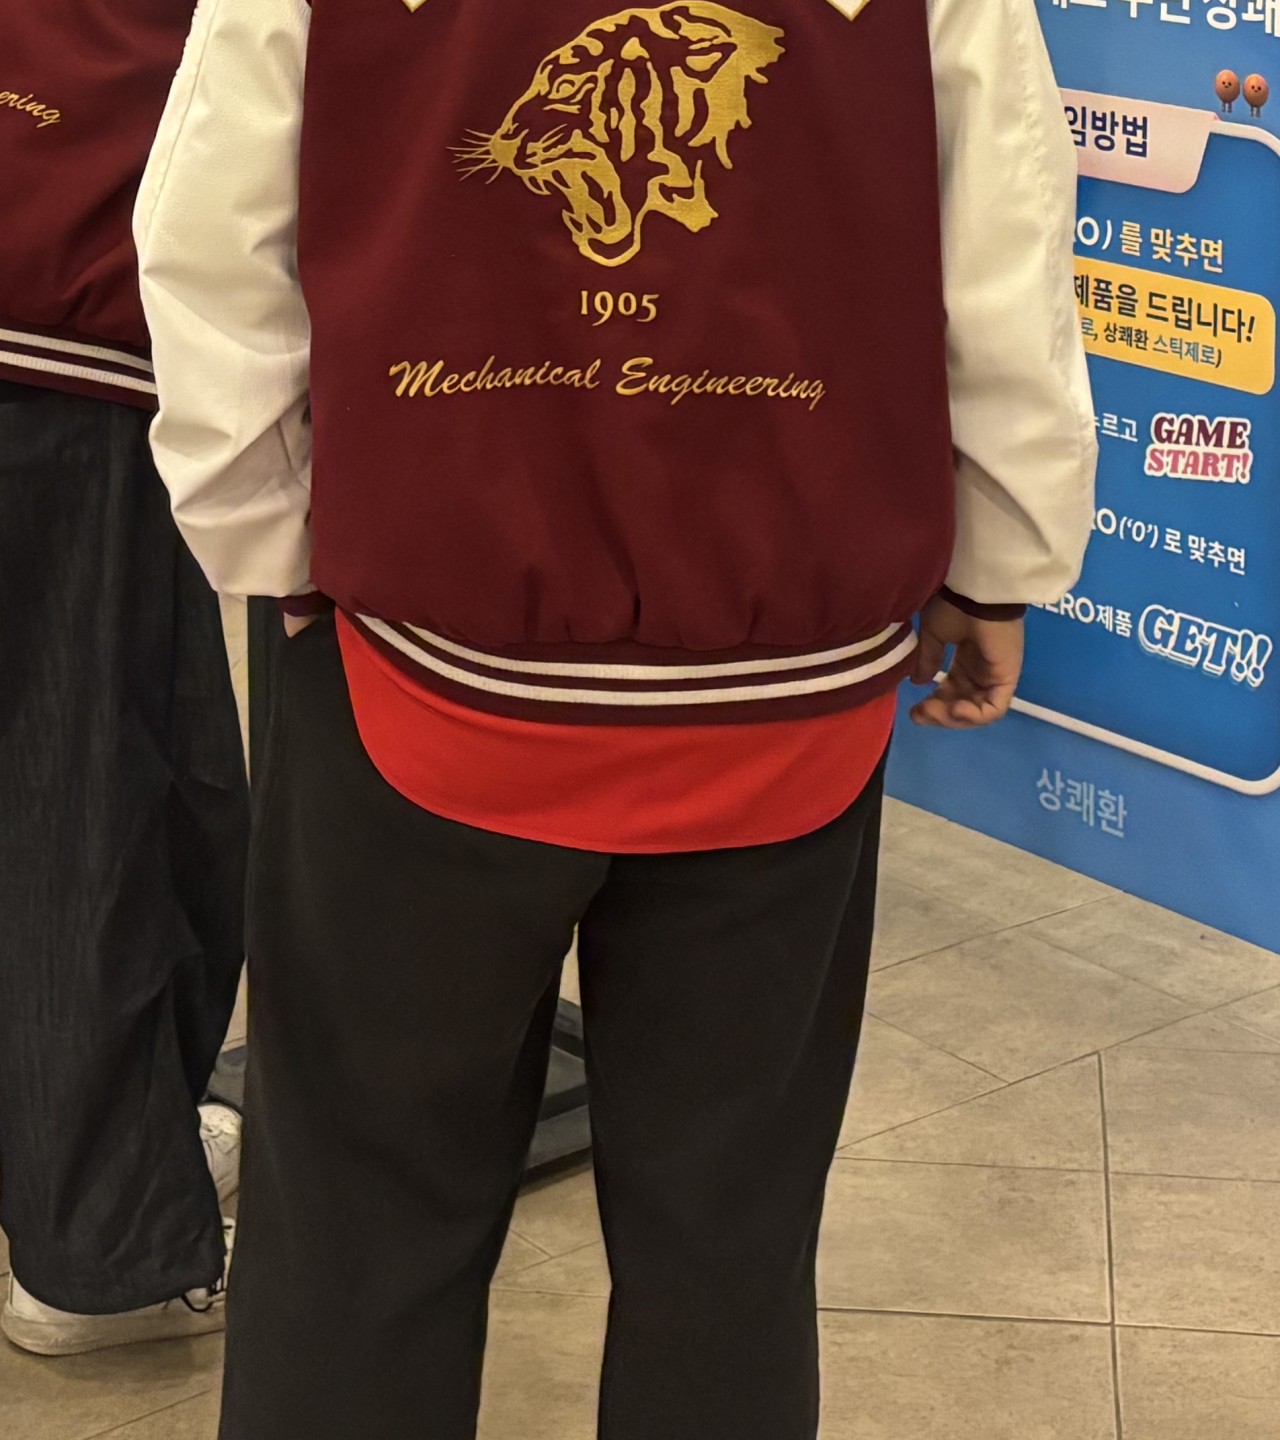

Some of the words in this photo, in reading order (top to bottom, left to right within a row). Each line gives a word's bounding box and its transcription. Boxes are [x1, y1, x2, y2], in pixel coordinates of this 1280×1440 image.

[1120, 220, 1143, 257] 를
[1150, 228, 1223, 274] 맞추면
[579, 289, 660, 326] 1905
[1146, 291, 1256, 343] 드립니다!
[1104, 322, 1149, 351] 상쾌환
[1153, 335, 1223, 368] 스틱제로)
[389, 355, 601, 399] Mechanical
[616, 356, 827, 411] Engineering
[1152, 415, 1250, 450] GAME
[1146, 447, 1253, 483] START!
[1163, 527, 1183, 556] 로
[1187, 534, 1246, 576] 맞추면
[1138, 603, 1273, 688] GET!!
[1036, 768, 1128, 838] 상쾌환
